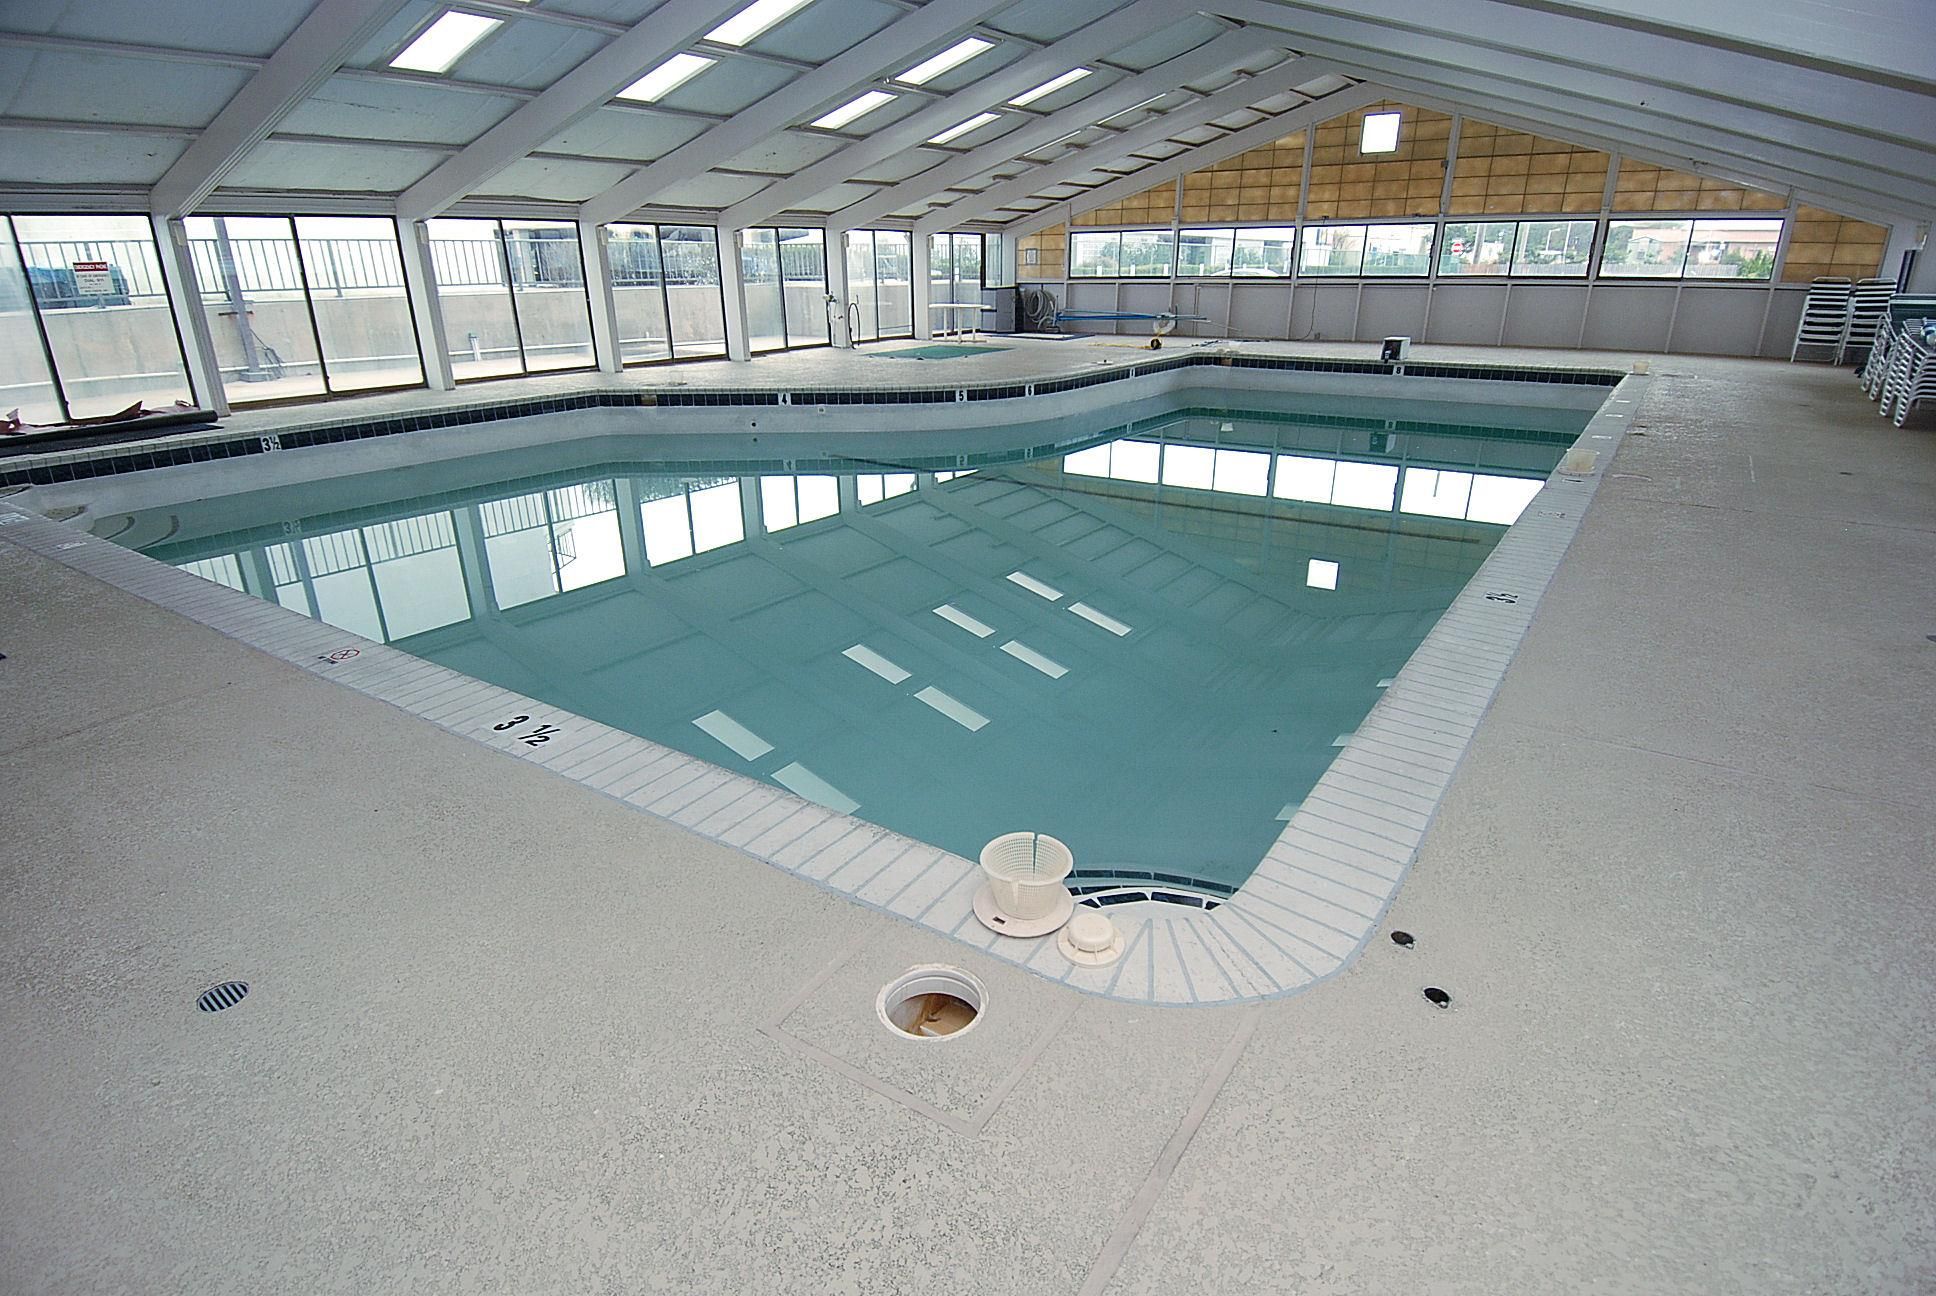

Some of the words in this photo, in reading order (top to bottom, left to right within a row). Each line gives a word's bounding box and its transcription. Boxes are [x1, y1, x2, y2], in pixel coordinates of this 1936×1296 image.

[1396, 366, 1401, 375] 8
[782, 393, 787, 405] 4
[959, 390, 964, 401] 5
[493, 715, 530, 731] 3
